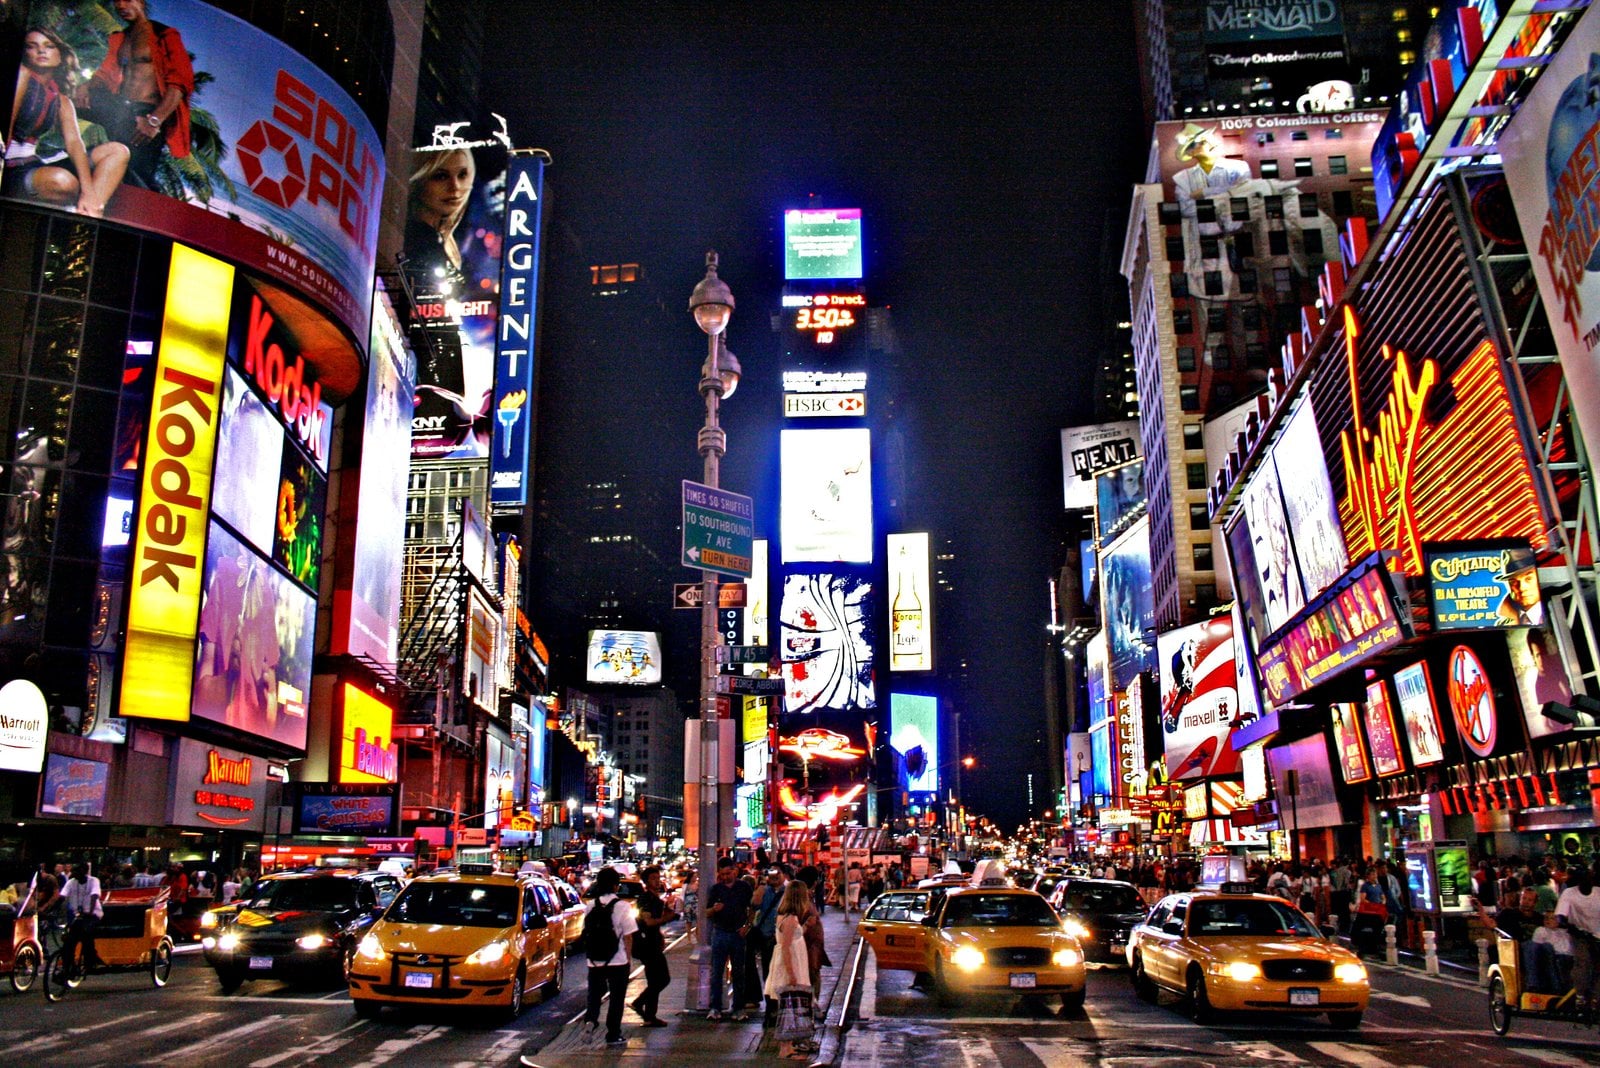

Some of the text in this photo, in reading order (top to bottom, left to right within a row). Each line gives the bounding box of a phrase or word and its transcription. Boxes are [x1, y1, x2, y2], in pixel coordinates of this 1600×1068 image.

[1207, 0, 1336, 31] MERMAID
[1221, 118, 1252, 129] 100%
[1256, 113, 1329, 128] Colombian
[501, 170, 539, 378] ARGENT
[245, 294, 327, 461] Kodak
[788, 399, 833, 411] HSBC
[411, 416, 447, 429] KNY
[142, 367, 216, 593] Kodak
[686, 489, 707, 505] TIMES
[708, 494, 719, 508] SQ
[686, 511, 751, 538] TO SOUTHBOUND
[706, 533, 733, 550] 7 AVE
[702, 550, 750, 572] TURN HERE
[733, 648, 741, 661] W
[744, 647, 756, 661] 45
[731, 677, 755, 689] GEORGE
[1184, 710, 1215, 728] maxell
[203, 750, 252, 786] Marriott
[331, 799, 370, 809] WHITE
